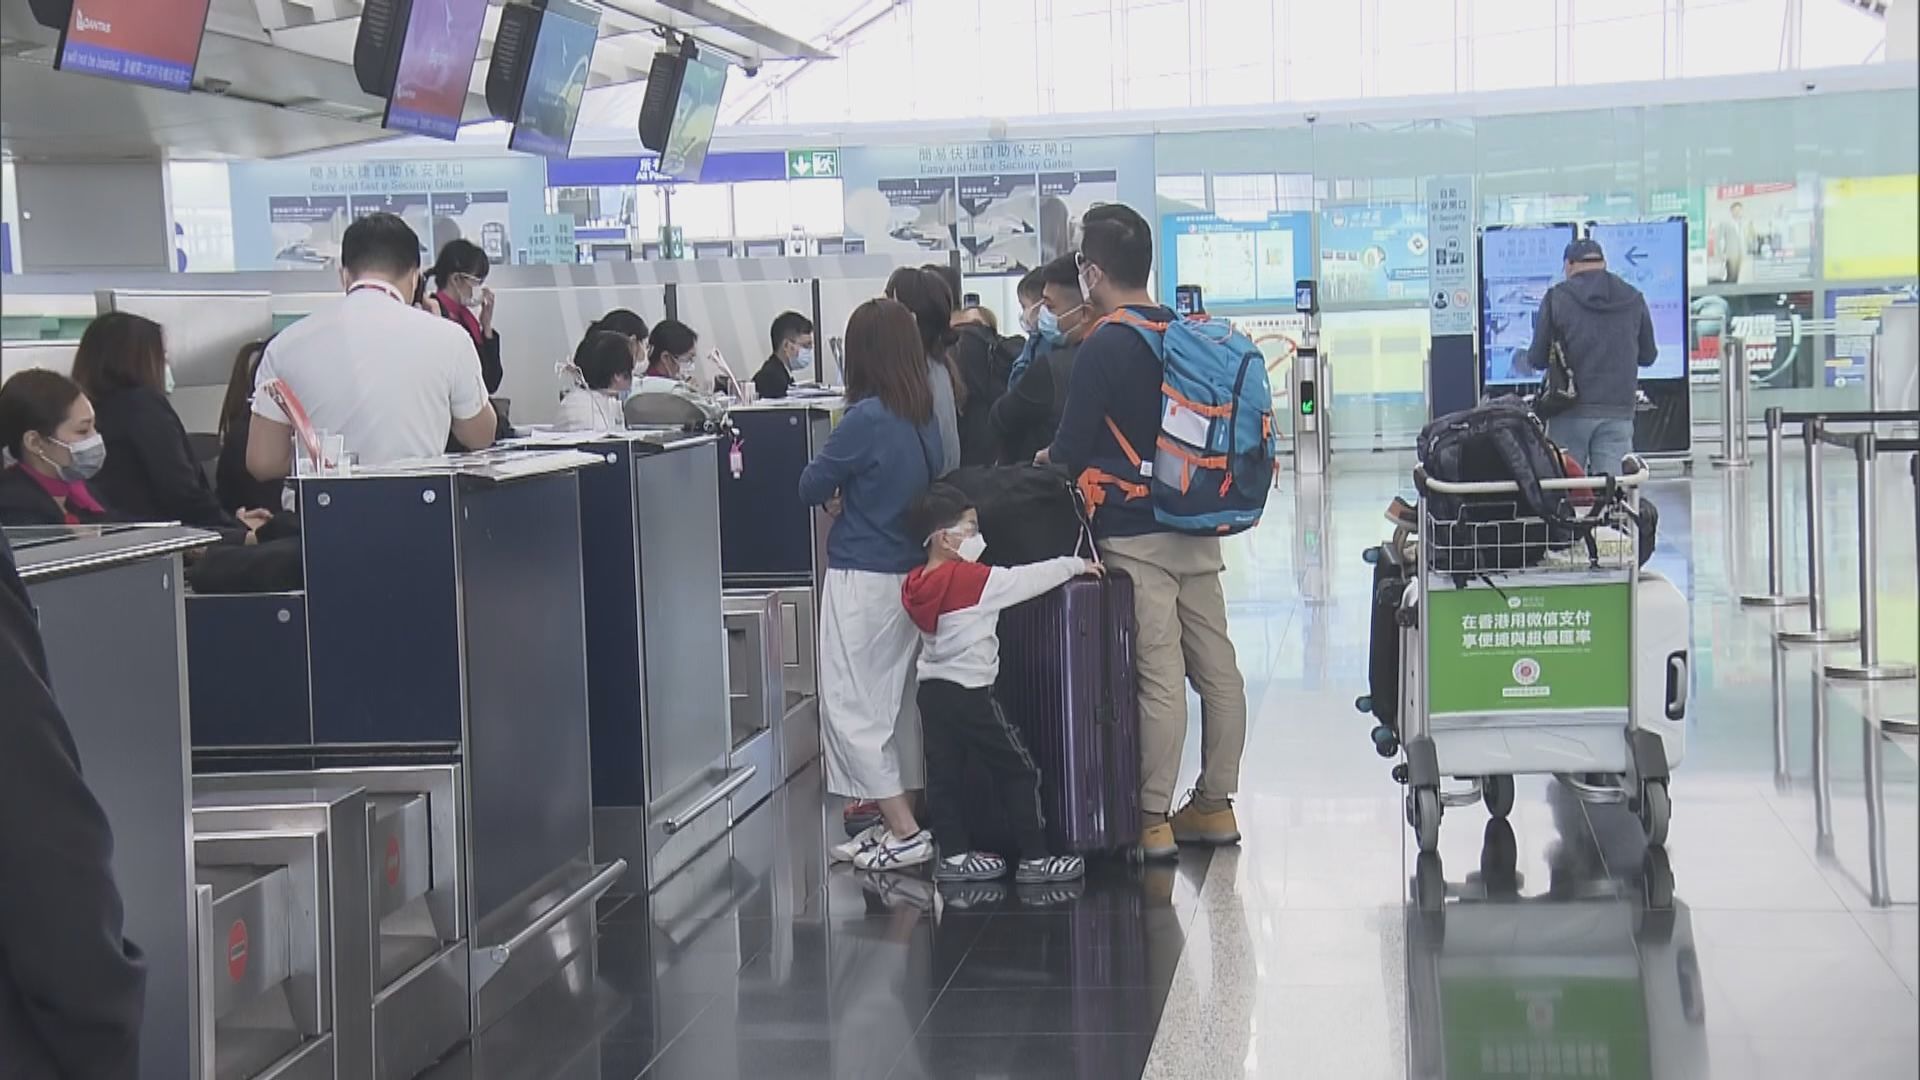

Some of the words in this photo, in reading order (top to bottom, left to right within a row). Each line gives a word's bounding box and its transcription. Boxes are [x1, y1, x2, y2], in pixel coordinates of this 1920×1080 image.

[1461, 610, 1592, 630] 在香港用微信支付
